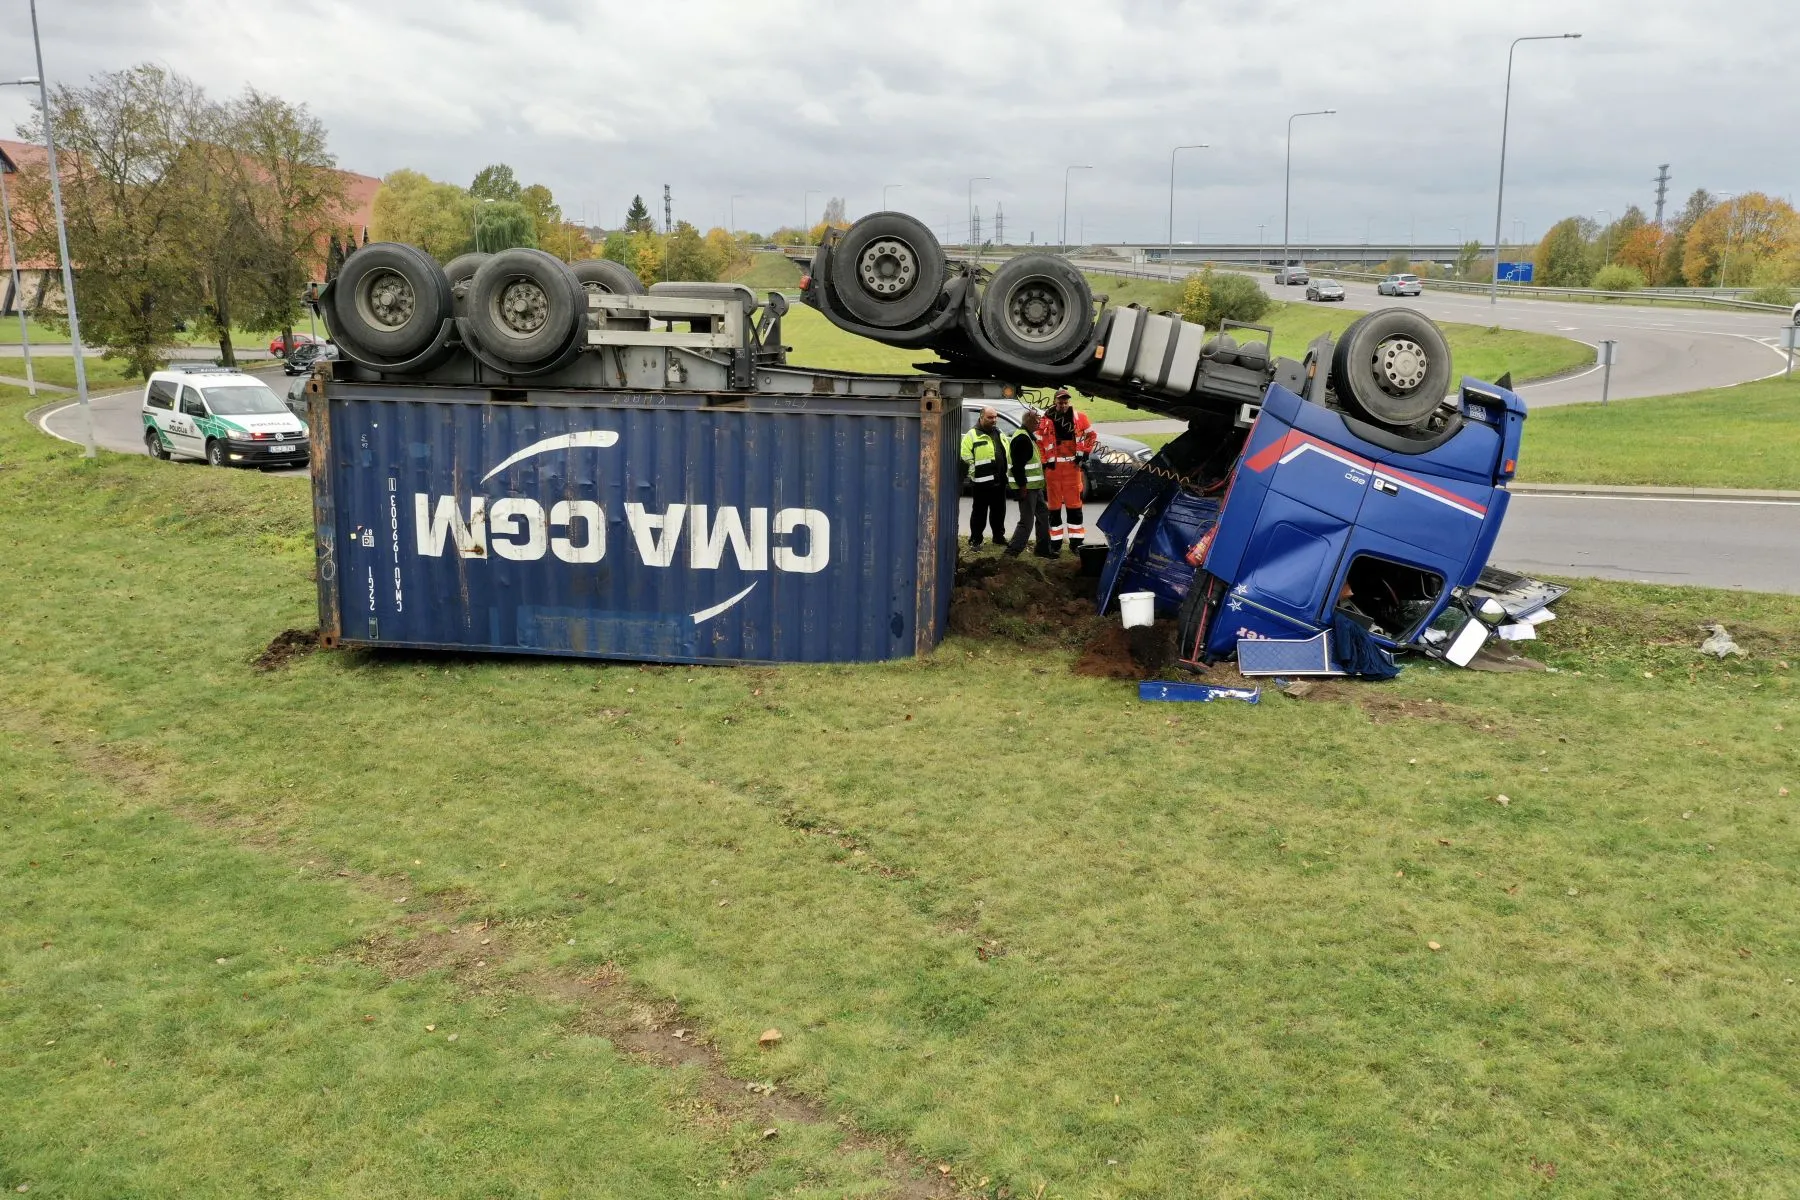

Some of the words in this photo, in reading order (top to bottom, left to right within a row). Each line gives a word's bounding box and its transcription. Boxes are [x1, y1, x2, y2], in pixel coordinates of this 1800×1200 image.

[364, 528, 373, 536] 87
[390, 495, 399, 563] 199003
[415, 493, 606, 563] CGM
[624, 502, 831, 573] CMA
[367, 566, 376, 611] 22G1
[394, 567, 404, 612] CMAU
